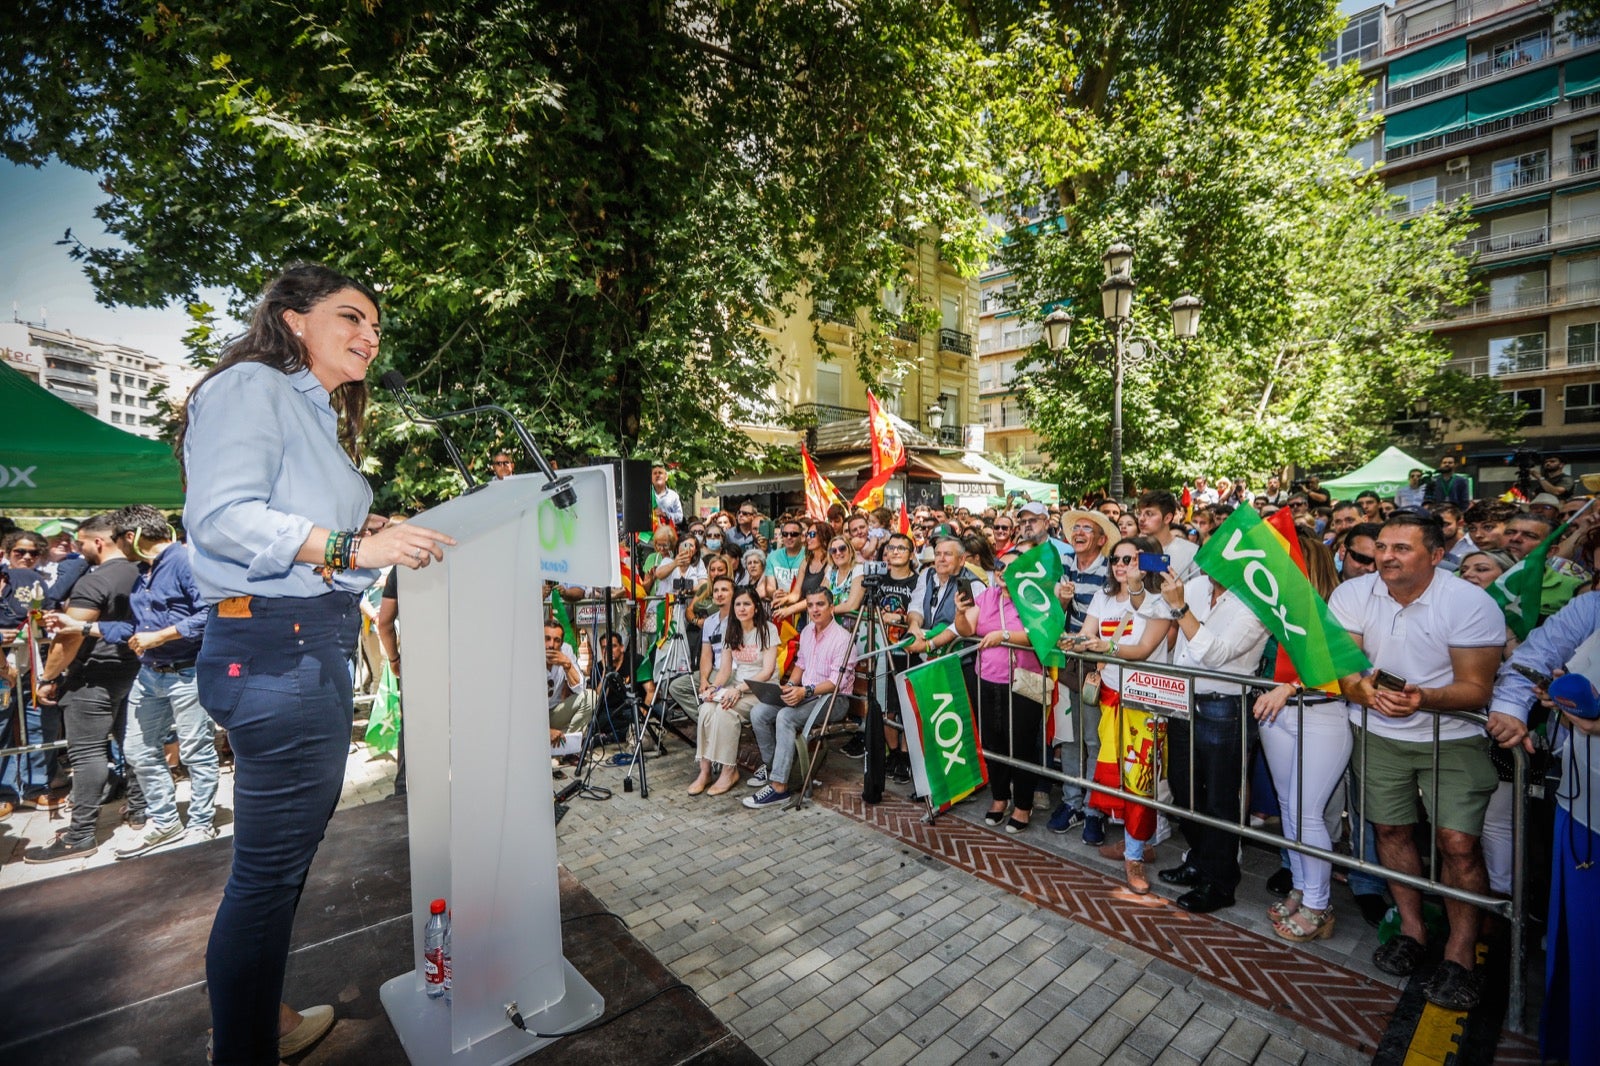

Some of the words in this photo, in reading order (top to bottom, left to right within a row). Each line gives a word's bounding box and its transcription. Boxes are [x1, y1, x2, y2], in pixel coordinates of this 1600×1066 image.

[757, 482, 784, 493] IDEAL
[958, 483, 991, 494] IDEAL
[1014, 561, 1051, 639] VOX
[1222, 527, 1307, 641] VOX
[1126, 672, 1186, 692] ALQUIMAQ
[930, 693, 966, 776] VOX
